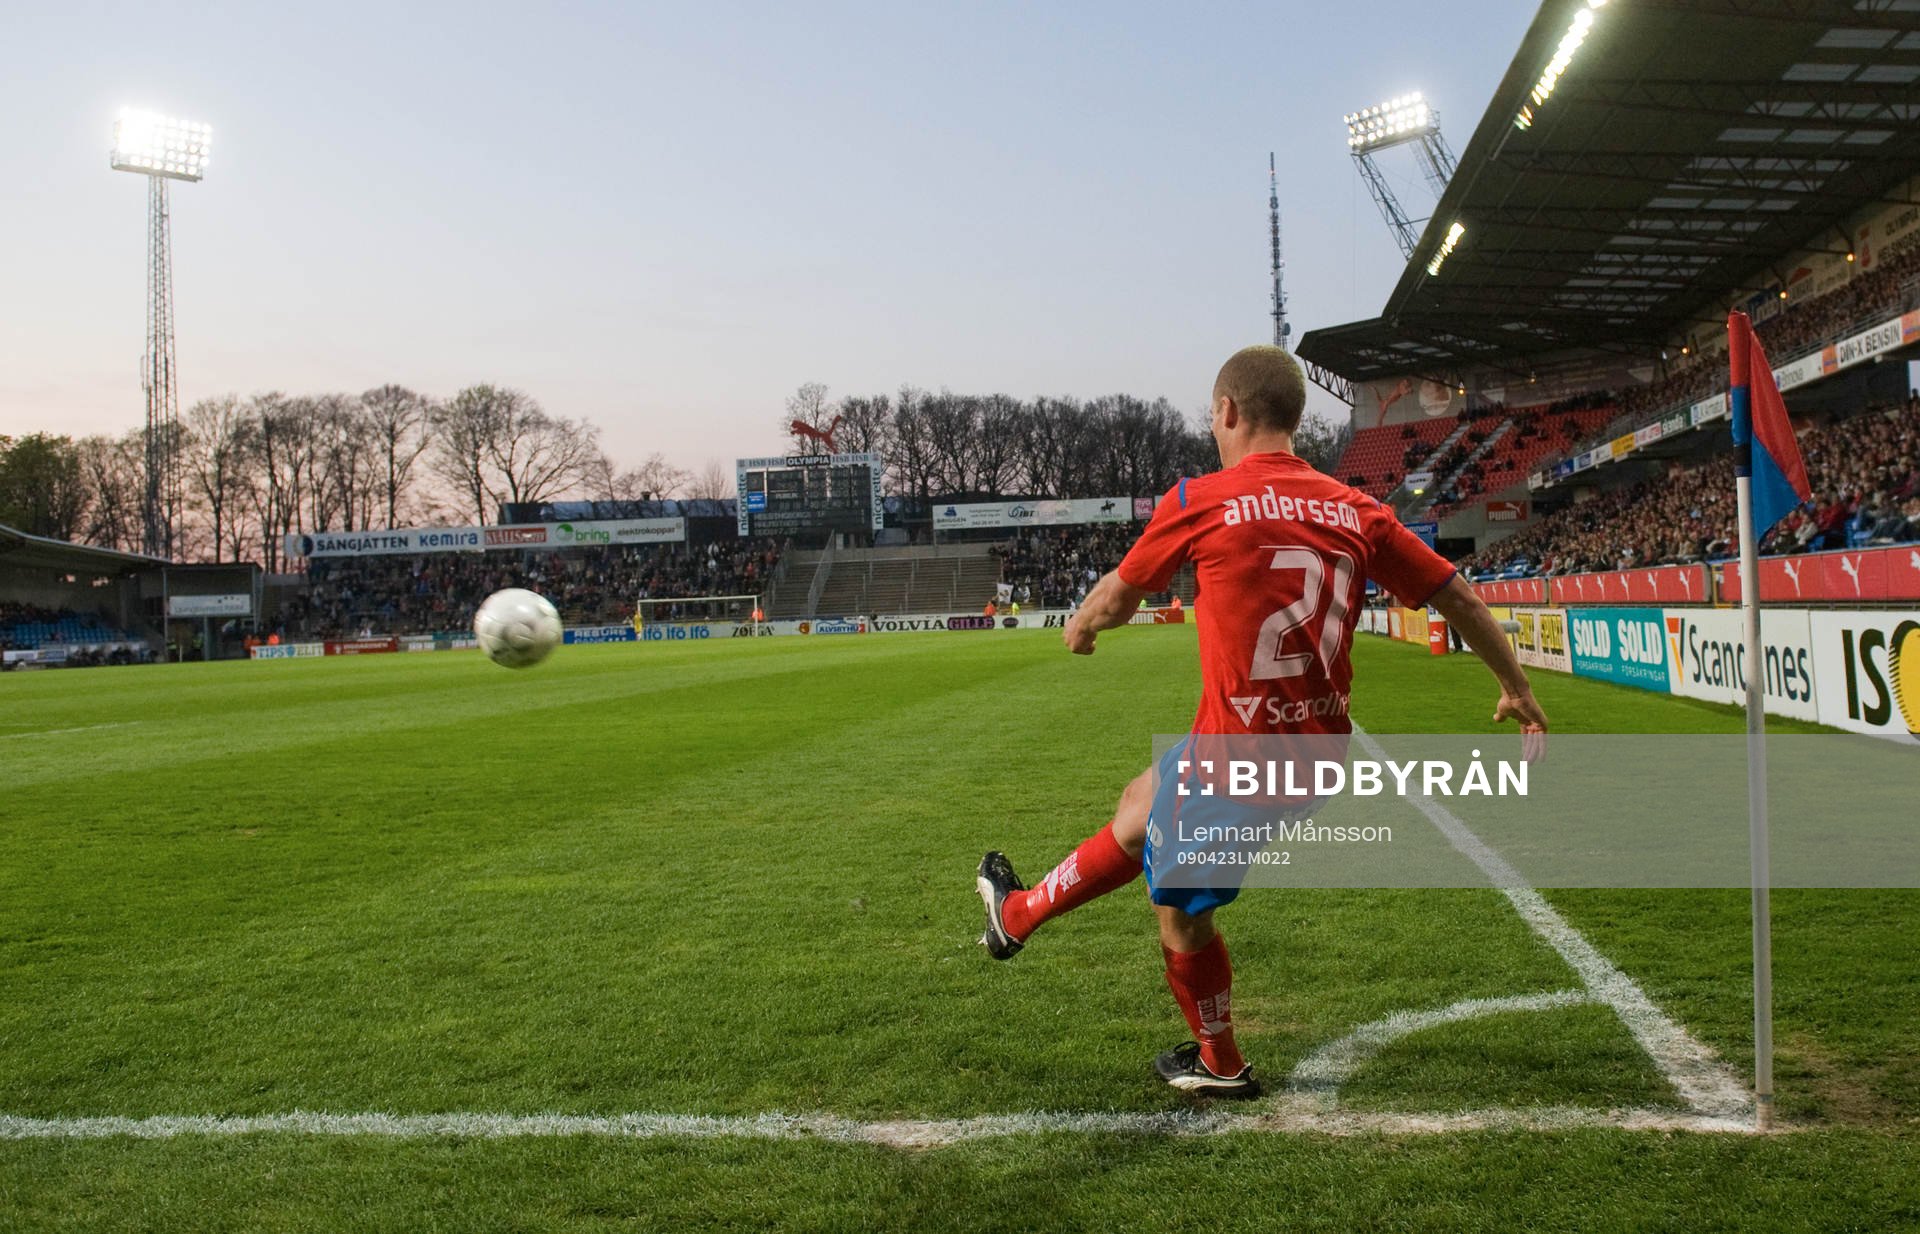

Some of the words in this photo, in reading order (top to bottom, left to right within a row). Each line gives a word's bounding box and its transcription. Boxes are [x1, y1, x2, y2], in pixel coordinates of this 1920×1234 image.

[1866, 322, 1900, 353] BENSIN
[787, 456, 829, 466] OLYMPIA
[872, 468, 882, 525] nicorette
[1222, 485, 1361, 533] andersson
[575, 527, 610, 543] bring
[617, 526, 676, 538] elektrokoppar
[873, 619, 948, 632] VOLVIA
[949, 617, 994, 630] GILLE
[1249, 545, 1356, 681] 21
[1573, 618, 1611, 658] SOLID
[1617, 618, 1663, 665] SOLID
[1689, 622, 1812, 703] Scannes
